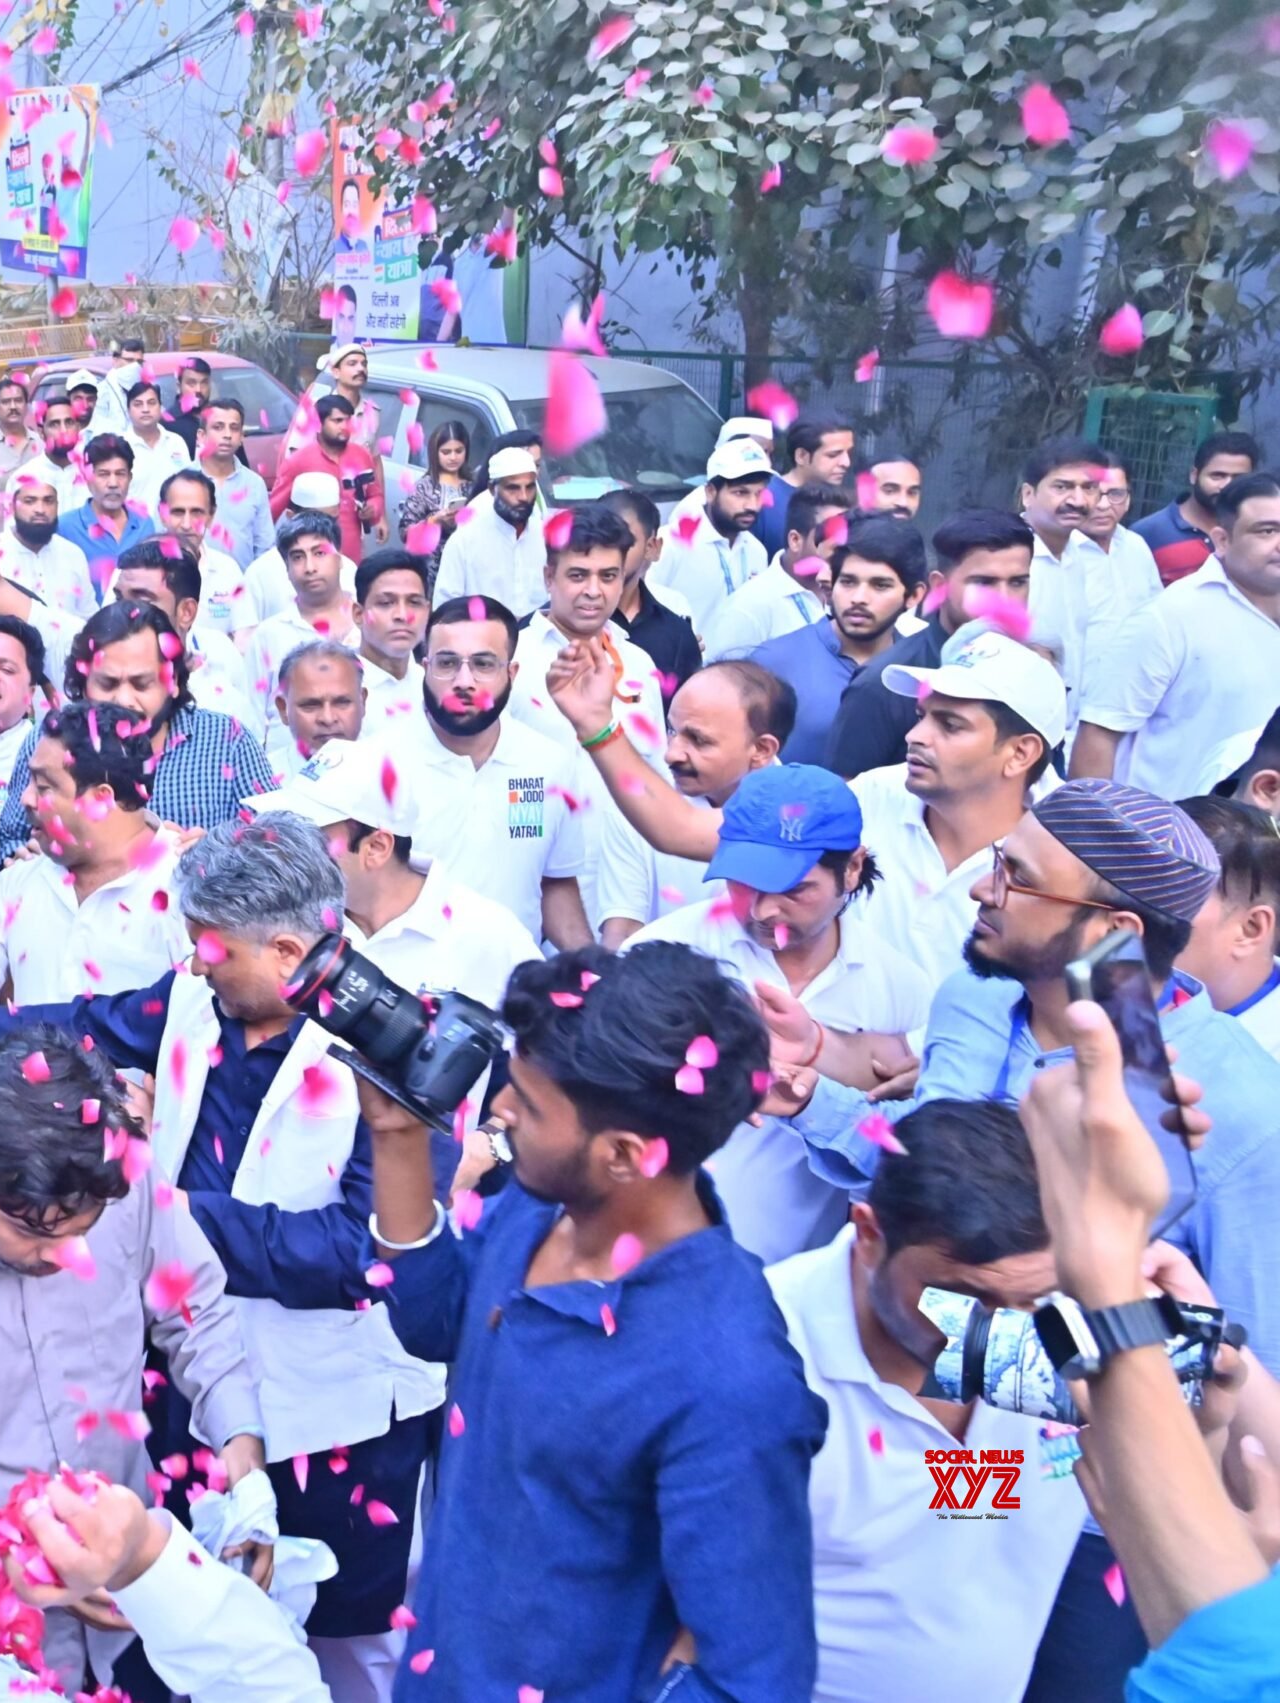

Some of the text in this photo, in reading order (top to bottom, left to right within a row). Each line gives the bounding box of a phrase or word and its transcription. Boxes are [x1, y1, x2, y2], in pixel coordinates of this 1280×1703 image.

[508, 777, 544, 790] BHARAT
[519, 790, 545, 803] JODO
[509, 825, 539, 839] YATRA
